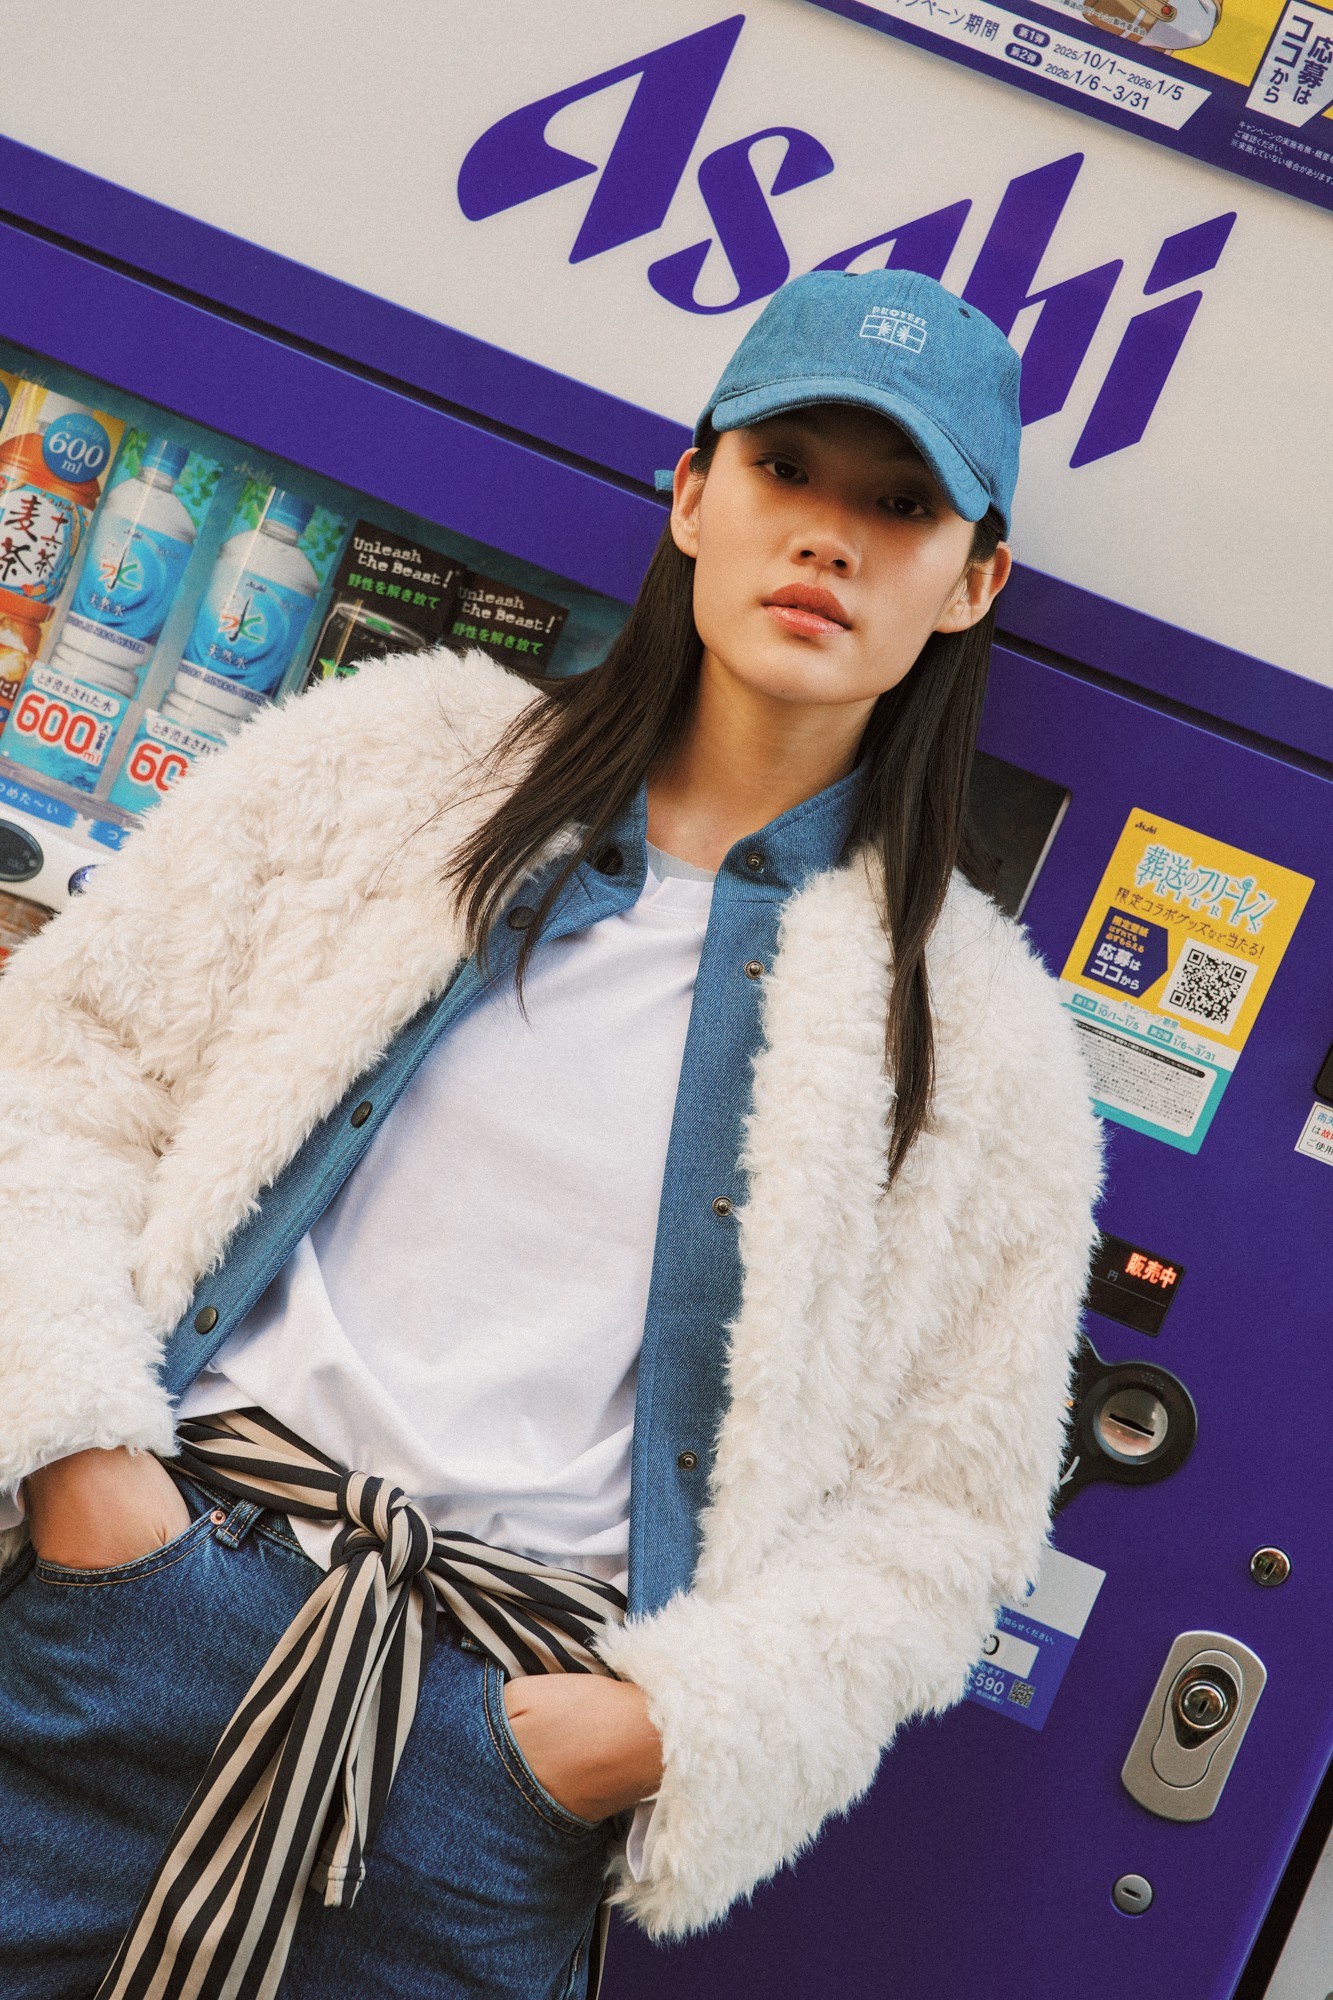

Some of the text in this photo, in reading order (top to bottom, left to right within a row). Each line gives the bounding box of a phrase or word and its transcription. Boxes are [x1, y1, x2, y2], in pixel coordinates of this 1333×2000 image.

[1017, 27, 1047, 45] 第1弾
[1010, 46, 1039, 64] 第2弾
[1263, 14, 1314, 104] ココから
[1292, 35, 1333, 105] 応募は
[48, 431, 104, 469] 600
[61, 459, 83, 475] ml
[353, 535, 422, 565] Unleash
[357, 552, 454, 589] the Beast!
[347, 572, 441, 610] 野性を解き放て
[457, 585, 526, 610] Unleash
[461, 601, 556, 635] the Beast!
[451, 621, 544, 656] 野性を解き放て
[16, 693, 97, 755] 600
[1137, 845, 1276, 922] 葬送のフリーレン
[1096, 942, 1142, 971] 応募は
[1090, 959, 1140, 990] ココから
[1106, 1269, 1119, 1282] 円
[1124, 1251, 1178, 1289] 販売中
[974, 1673, 1005, 1695] 590
